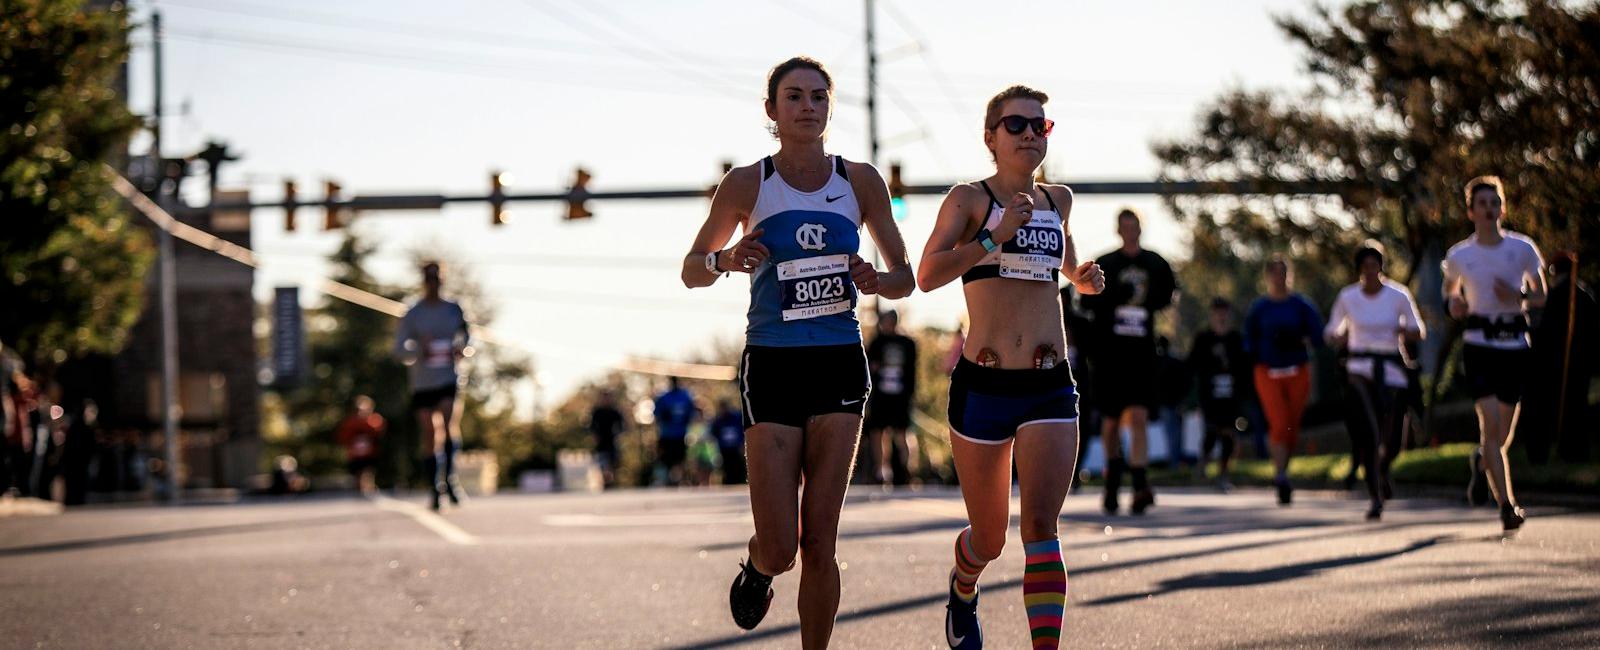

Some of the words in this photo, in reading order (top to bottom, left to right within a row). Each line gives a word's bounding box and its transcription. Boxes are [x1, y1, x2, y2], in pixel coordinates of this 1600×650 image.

[1016, 228, 1058, 251] 8499
[795, 276, 844, 302] 8023
[801, 306, 837, 317] MARATHON
